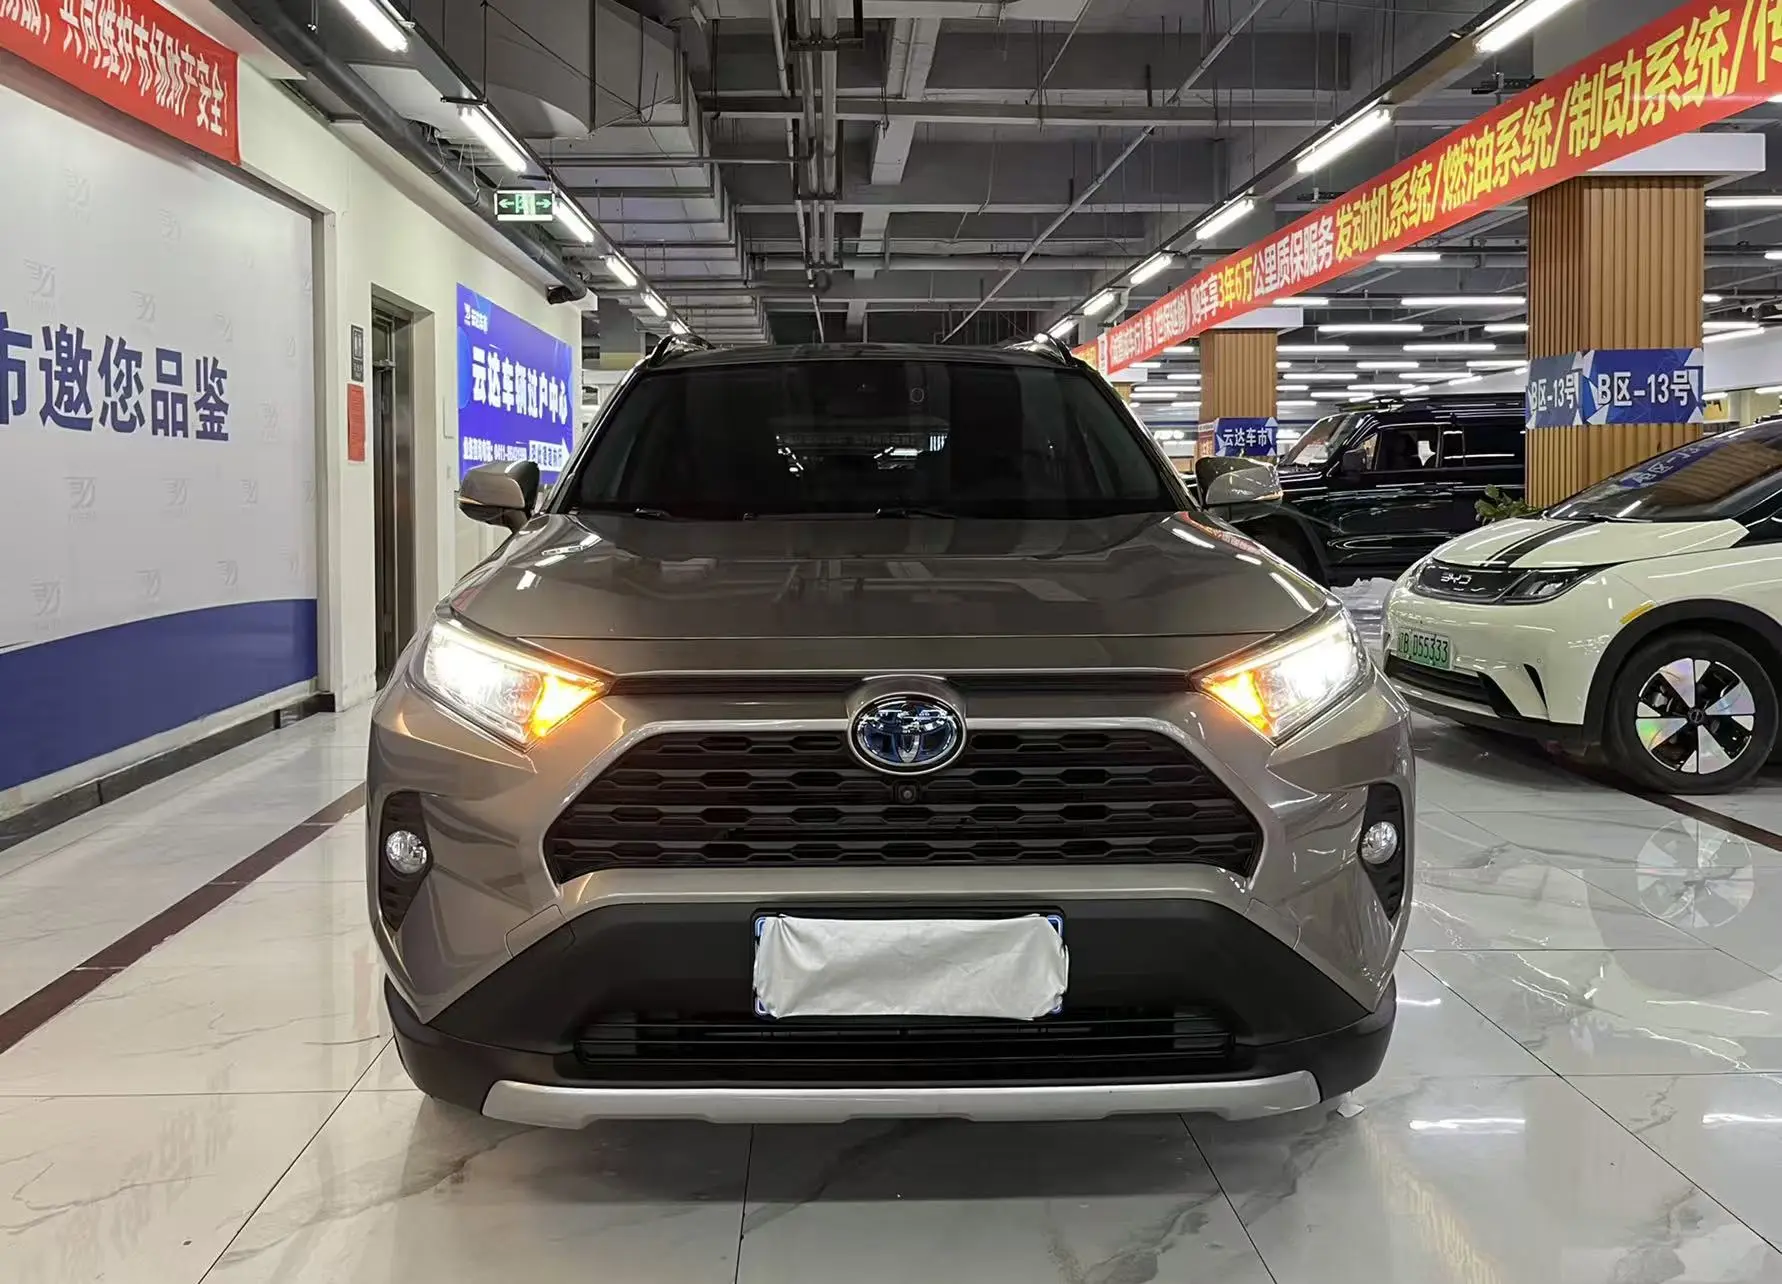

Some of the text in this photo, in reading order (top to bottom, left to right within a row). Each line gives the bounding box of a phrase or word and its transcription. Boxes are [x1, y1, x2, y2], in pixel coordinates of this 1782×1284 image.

[472, 346, 568, 425] 云达车辆过户中心
[1531, 374, 1577, 412] B区-13号
[1597, 370, 1691, 407] B区-13号
[1223, 427, 1268, 447] 云达车市
